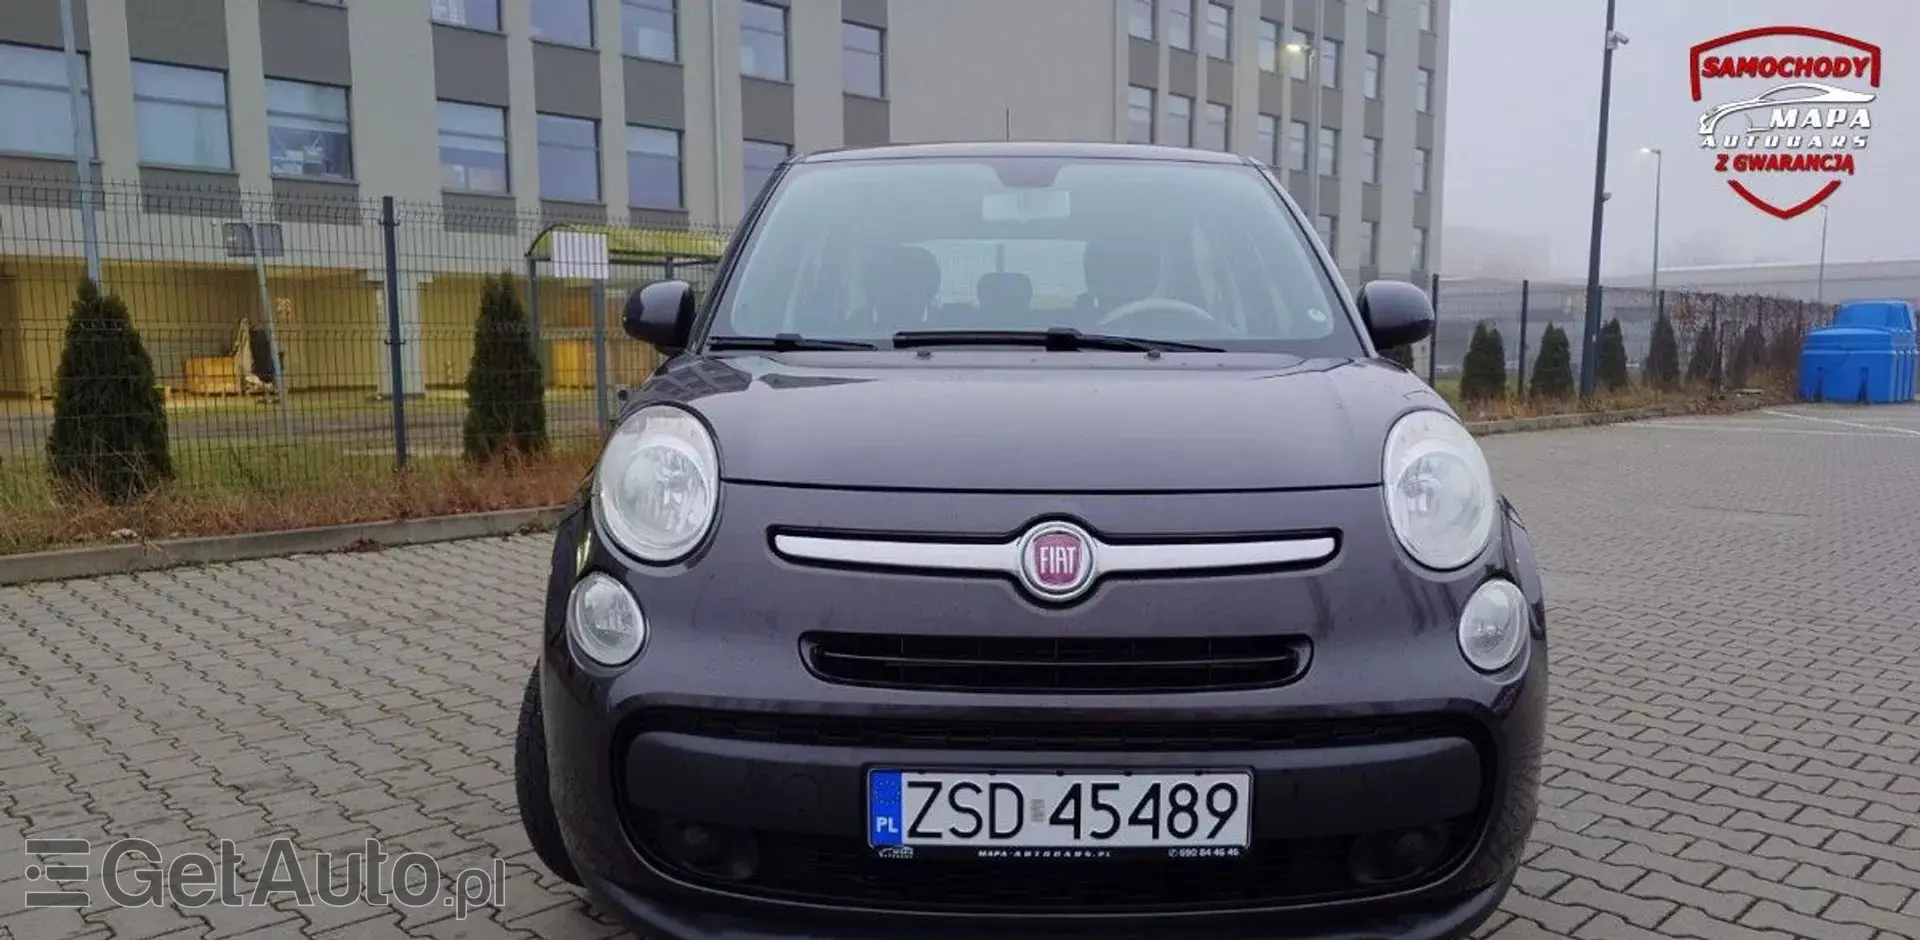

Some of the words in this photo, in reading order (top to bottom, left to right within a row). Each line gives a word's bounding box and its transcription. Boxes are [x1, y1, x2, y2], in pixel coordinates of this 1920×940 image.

[1040, 546, 1077, 575] FIAT
[876, 816, 898, 833] PL
[907, 781, 1024, 839] ZSD
[1049, 782, 1239, 840] 45489
